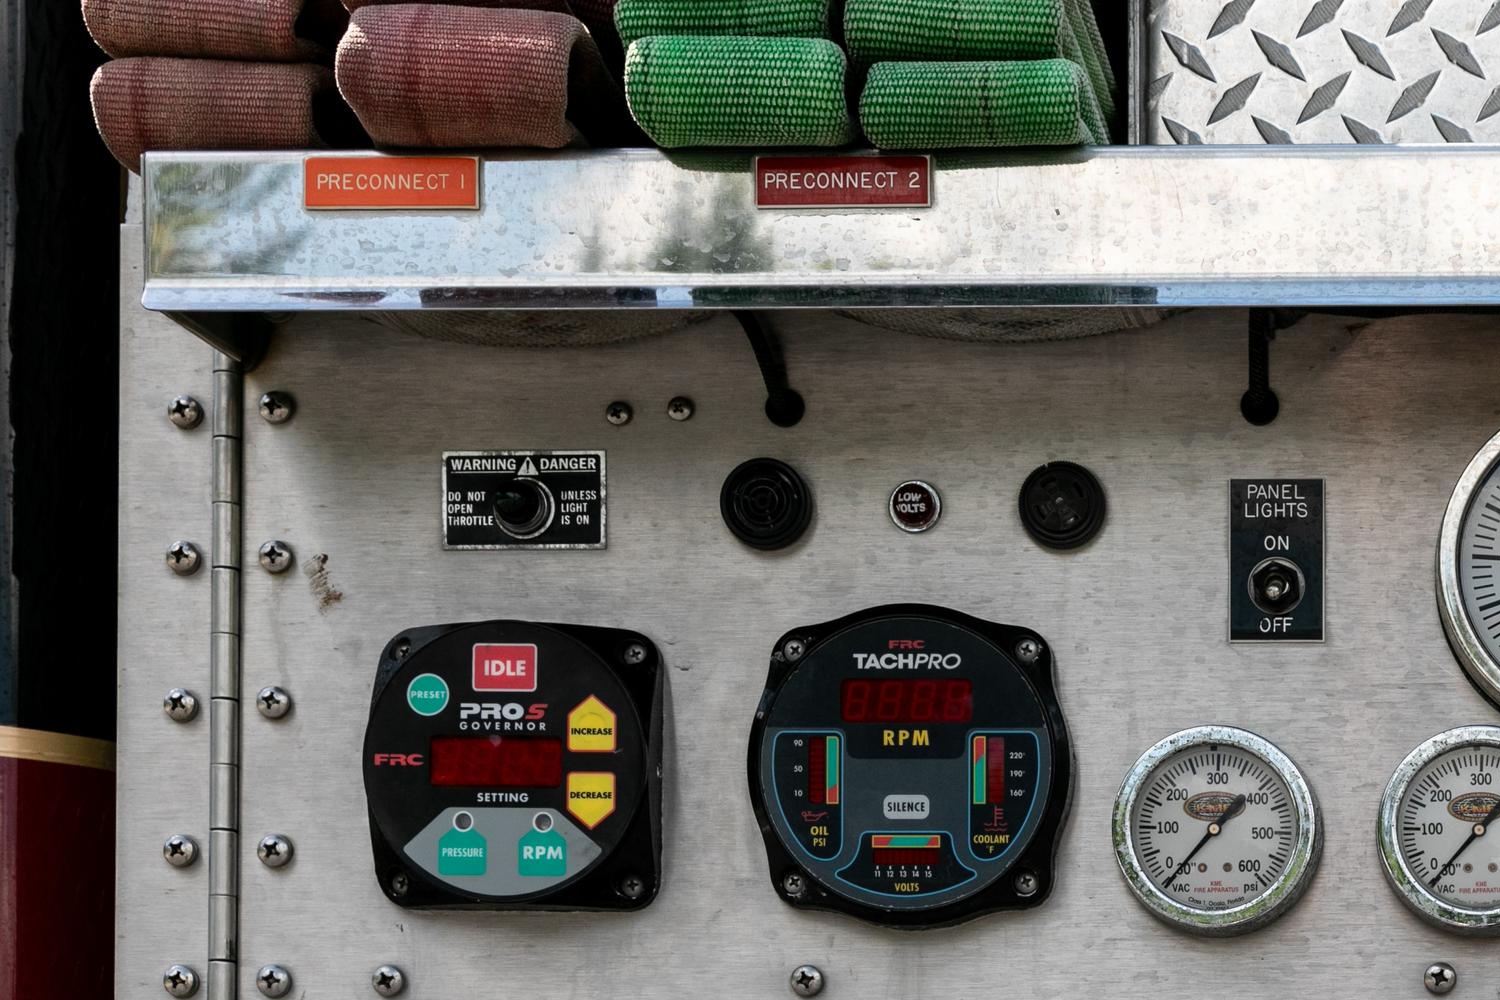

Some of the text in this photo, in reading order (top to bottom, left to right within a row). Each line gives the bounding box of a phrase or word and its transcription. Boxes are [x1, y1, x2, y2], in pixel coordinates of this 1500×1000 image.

[316, 173, 450, 190] PRECONNECT
[765, 172, 920, 189] PRECONNECT 2
[451, 458, 596, 470] WARNING DANGER
[448, 491, 486, 501] DO NOT
[561, 490, 597, 500] UNLESS
[898, 492, 921, 502] LOW
[1247, 484, 1305, 500] PANEL
[448, 504, 473, 513] OPEN
[561, 503, 587, 512] LIGHT
[896, 503, 926, 513] VOLTS
[1244, 502, 1308, 518] LIGHTS
[448, 516, 493, 526] THROTTLE
[561, 515, 589, 525] IS ON
[1264, 535, 1289, 551] ON
[1259, 617, 1293, 633] OFF
[888, 640, 925, 649] FRC
[853, 653, 961, 669] TACHPRO
[484, 660, 526, 676] IDLE
[411, 690, 446, 699] PRESET
[460, 722, 546, 731] GOVERNOR
[571, 727, 612, 736] INCREASE
[793, 739, 803, 747] 90
[883, 730, 929, 746] RPM
[374, 753, 424, 767] FRC
[793, 765, 803, 773] 50
[1206, 772, 1229, 785] 300
[1470, 773, 1492, 786] 300
[477, 792, 529, 802] SETTING
[570, 791, 612, 800] DECREASE
[794, 789, 803, 797] 10
[887, 802, 925, 813] SILENCE
[810, 825, 828, 836] OIL
[1251, 827, 1273, 839] 500
[813, 837, 826, 847] PSI
[973, 834, 1010, 844] COOLANT
[442, 848, 483, 858] PRESSURE
[523, 846, 563, 860] RPM
[894, 882, 919, 892] VOLTS
